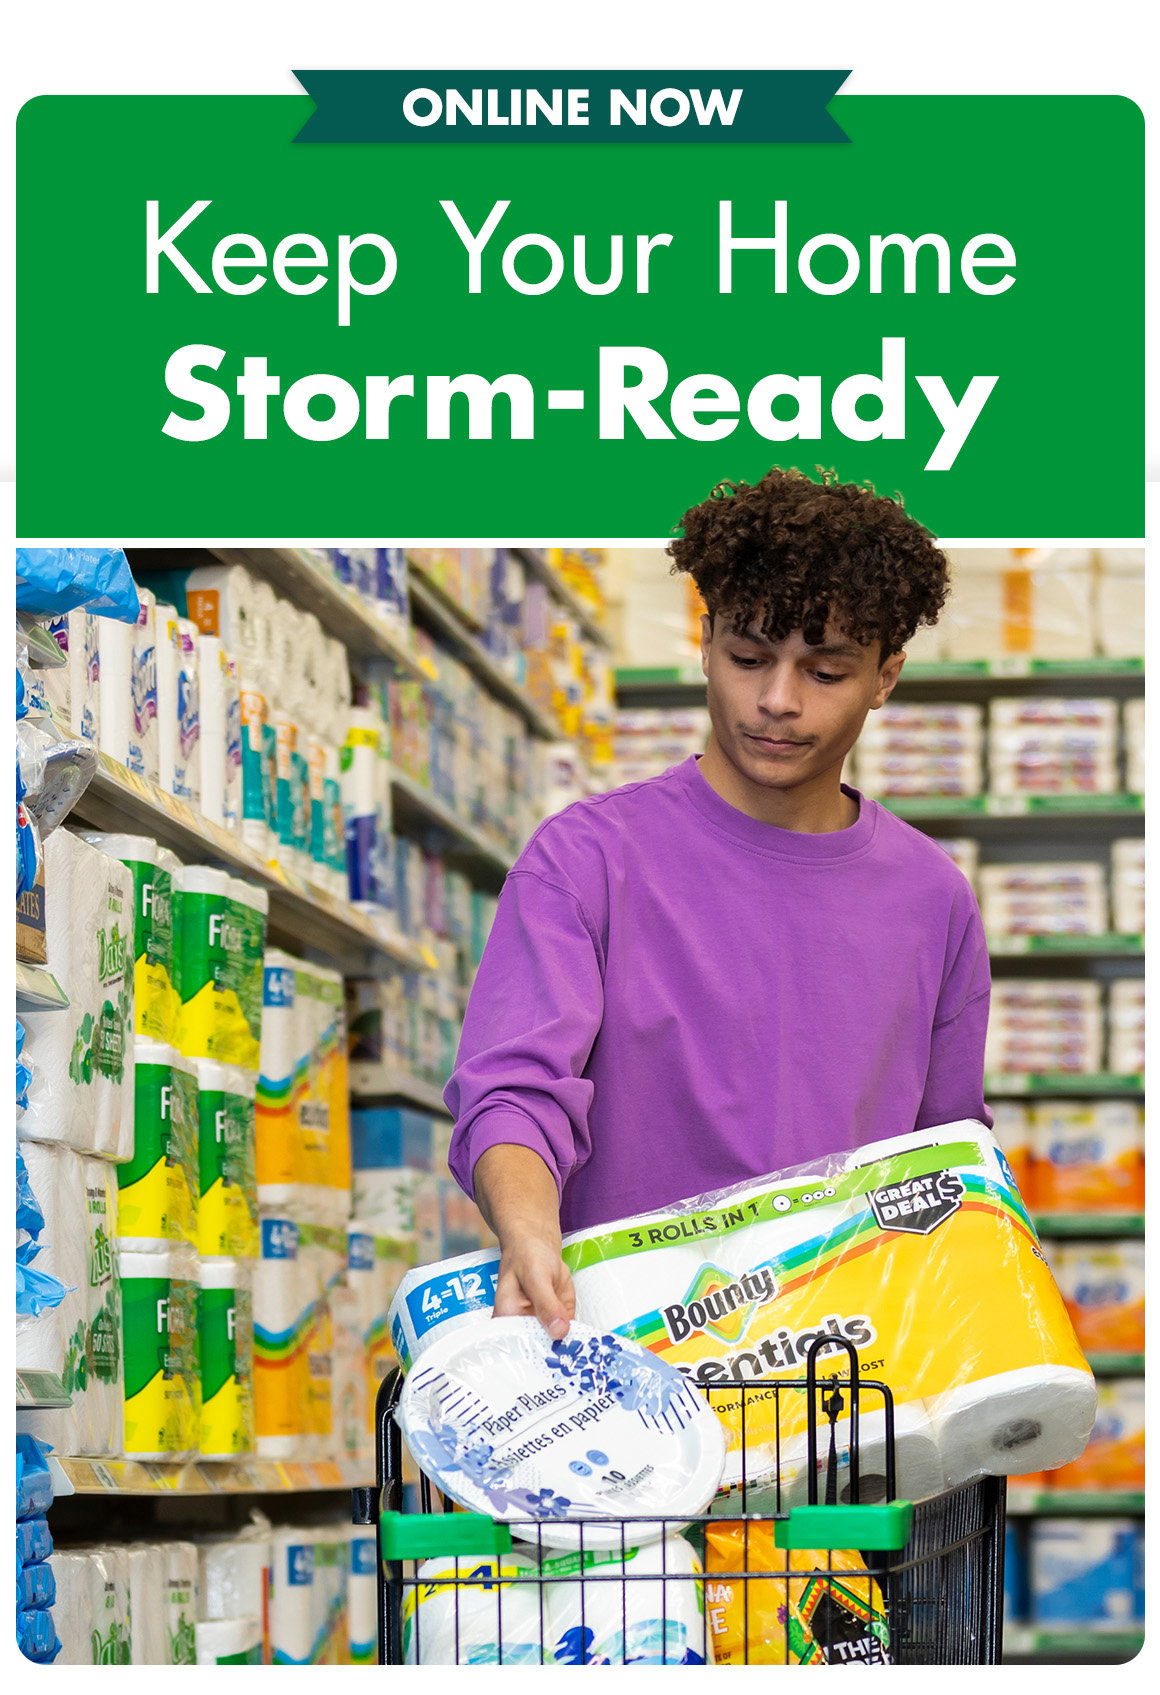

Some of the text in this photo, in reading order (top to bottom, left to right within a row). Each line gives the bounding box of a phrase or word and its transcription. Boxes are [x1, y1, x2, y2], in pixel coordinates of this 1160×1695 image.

[874, 1179, 934, 1204] GREAT
[881, 1193, 944, 1221] DEAL
[629, 1202, 760, 1248] 3 ROLLS IN 1
[425, 1307, 449, 1322] Triple
[664, 1268, 774, 1343] Bounty
[857, 1359, 886, 1374] OST
[482, 1383, 567, 1436] Paper Plates
[490, 1393, 617, 1469] Assiettes en papier
[601, 1470, 626, 1484] 10
[465, 1565, 492, 1590] 4
[833, 1636, 879, 1661] THE
